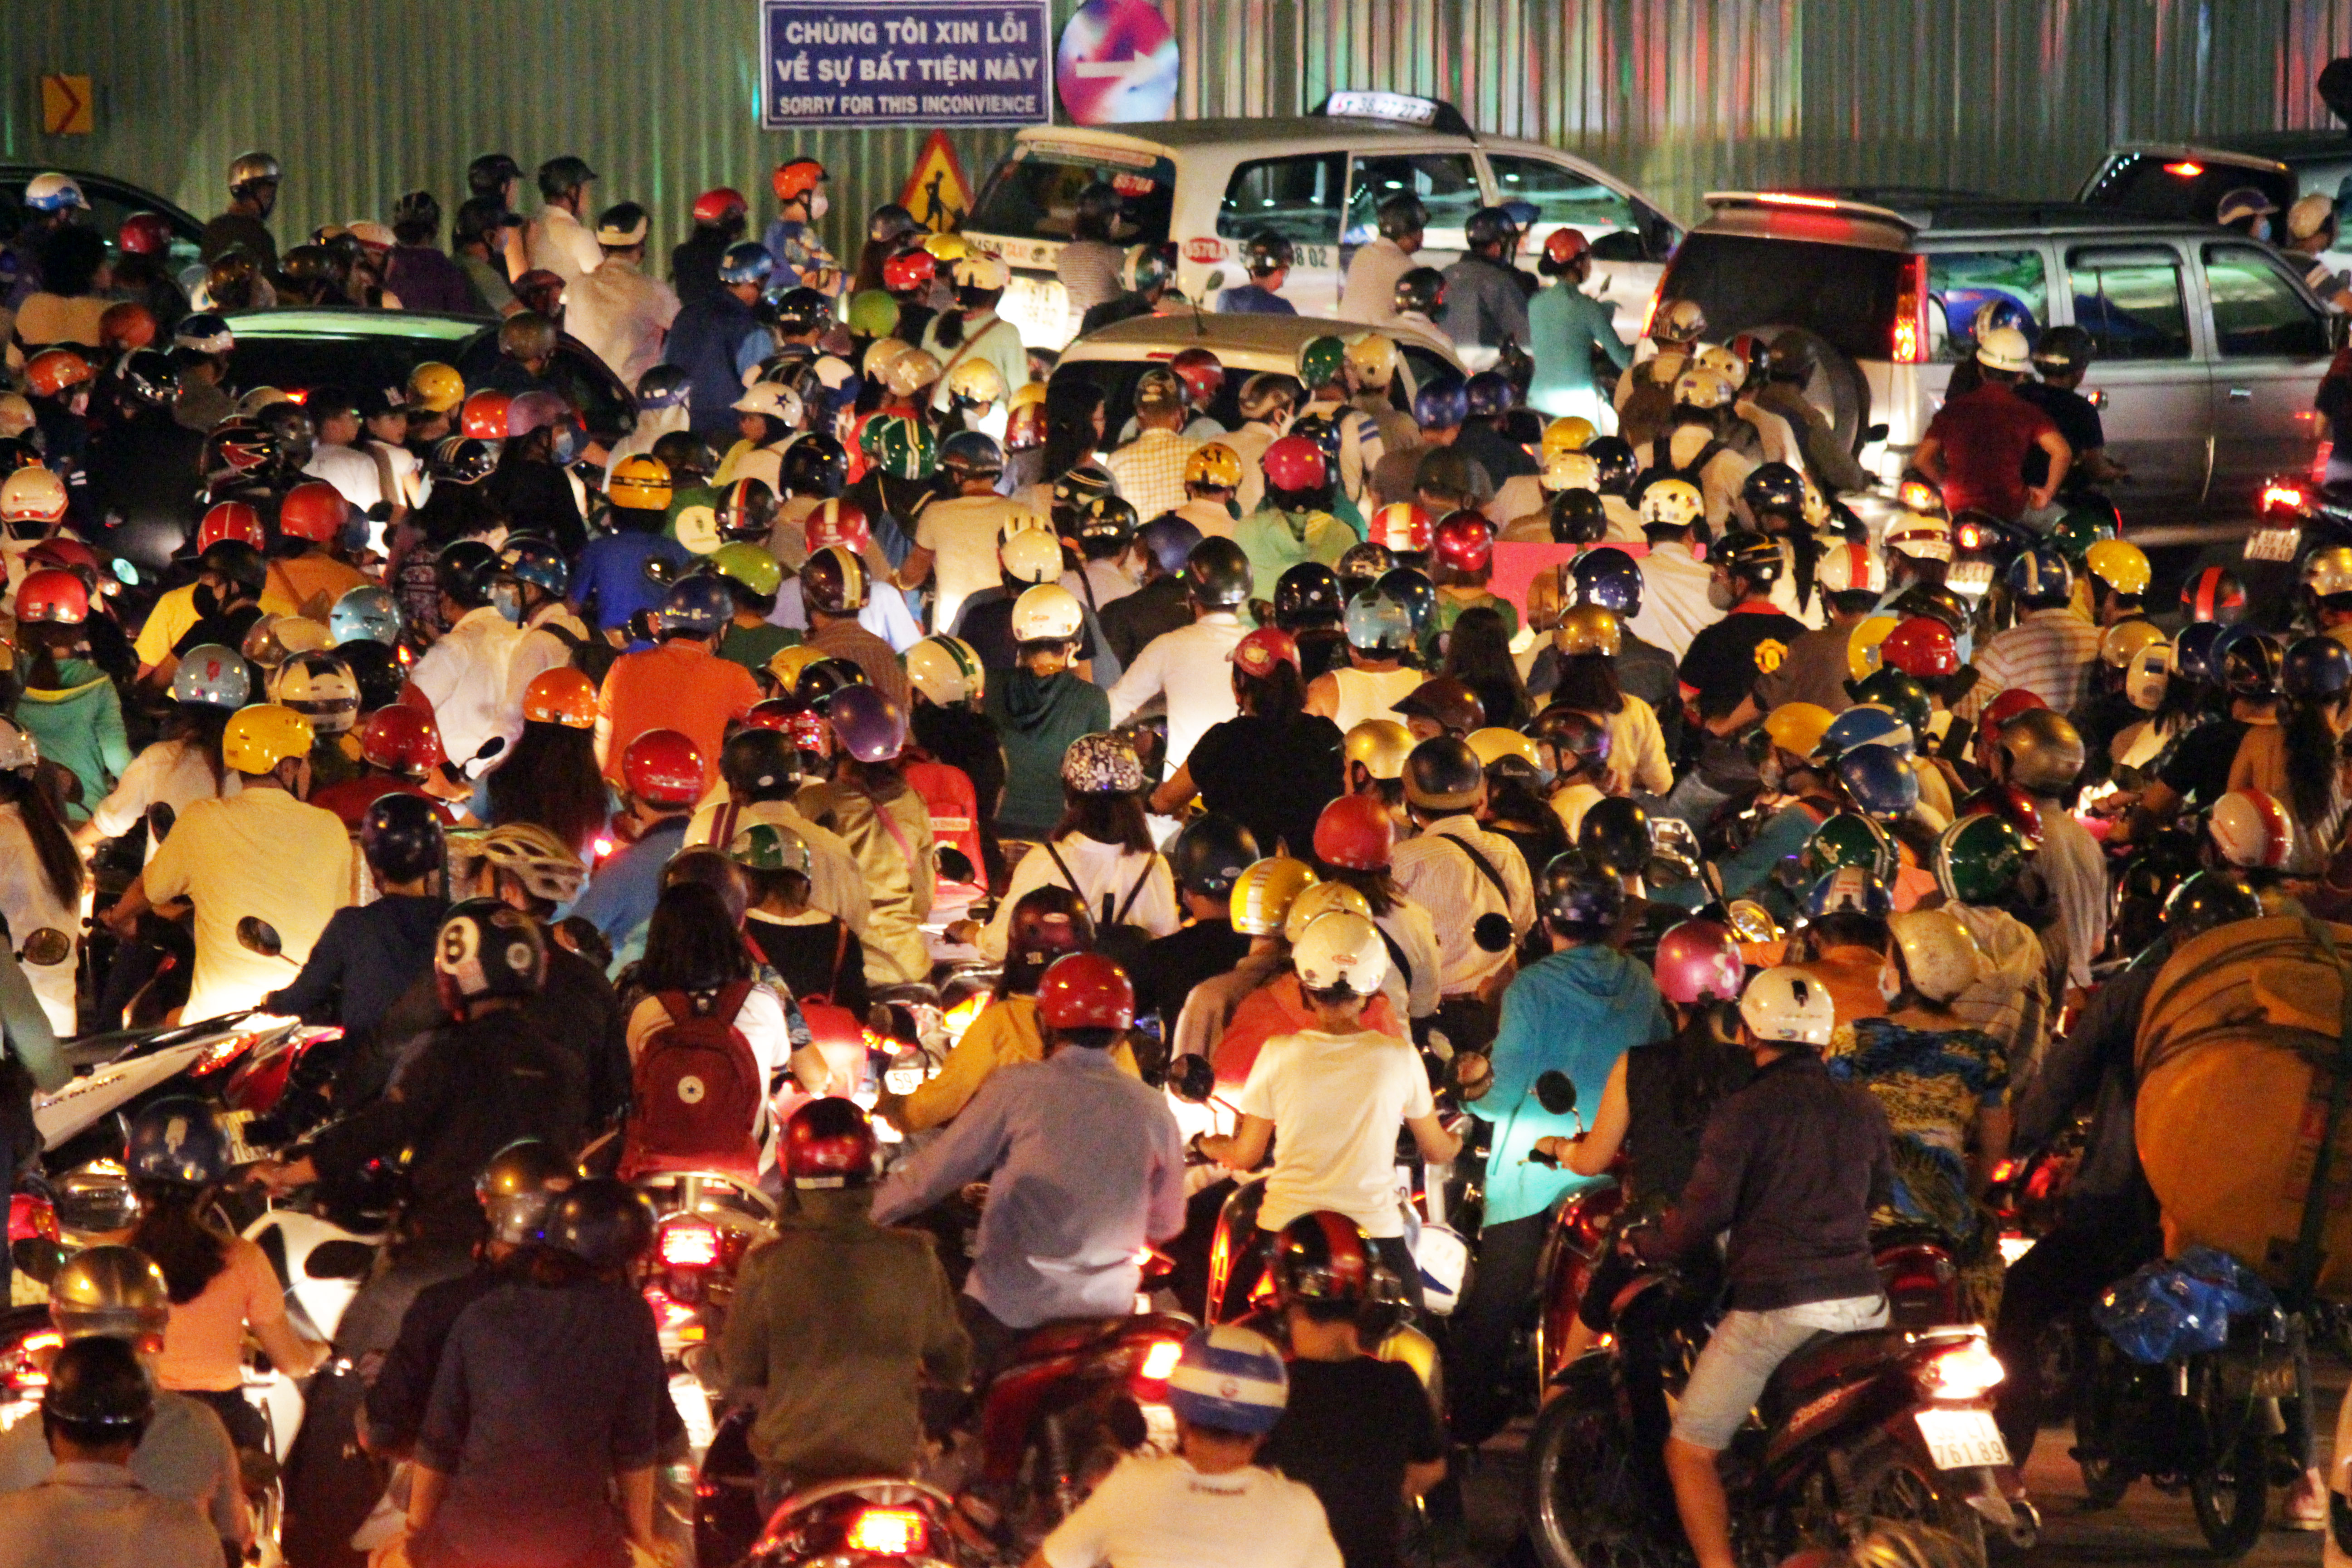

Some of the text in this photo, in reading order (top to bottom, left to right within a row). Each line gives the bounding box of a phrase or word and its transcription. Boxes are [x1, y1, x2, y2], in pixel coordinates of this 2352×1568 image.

[884, 16, 927, 44] TÔI
[935, 20, 979, 44] XIN
[986, 11, 1027, 44] LỖI
[818, 55, 853, 87] SỰ
[860, 49, 911, 81] BẤT
[917, 53, 977, 86] TIỆN
[985, 52, 1038, 81] NÀY
[779, 94, 1035, 115] SORRY FOR THIS INCONVIENCE
[1933, 1441, 2005, 1465] 761.89
